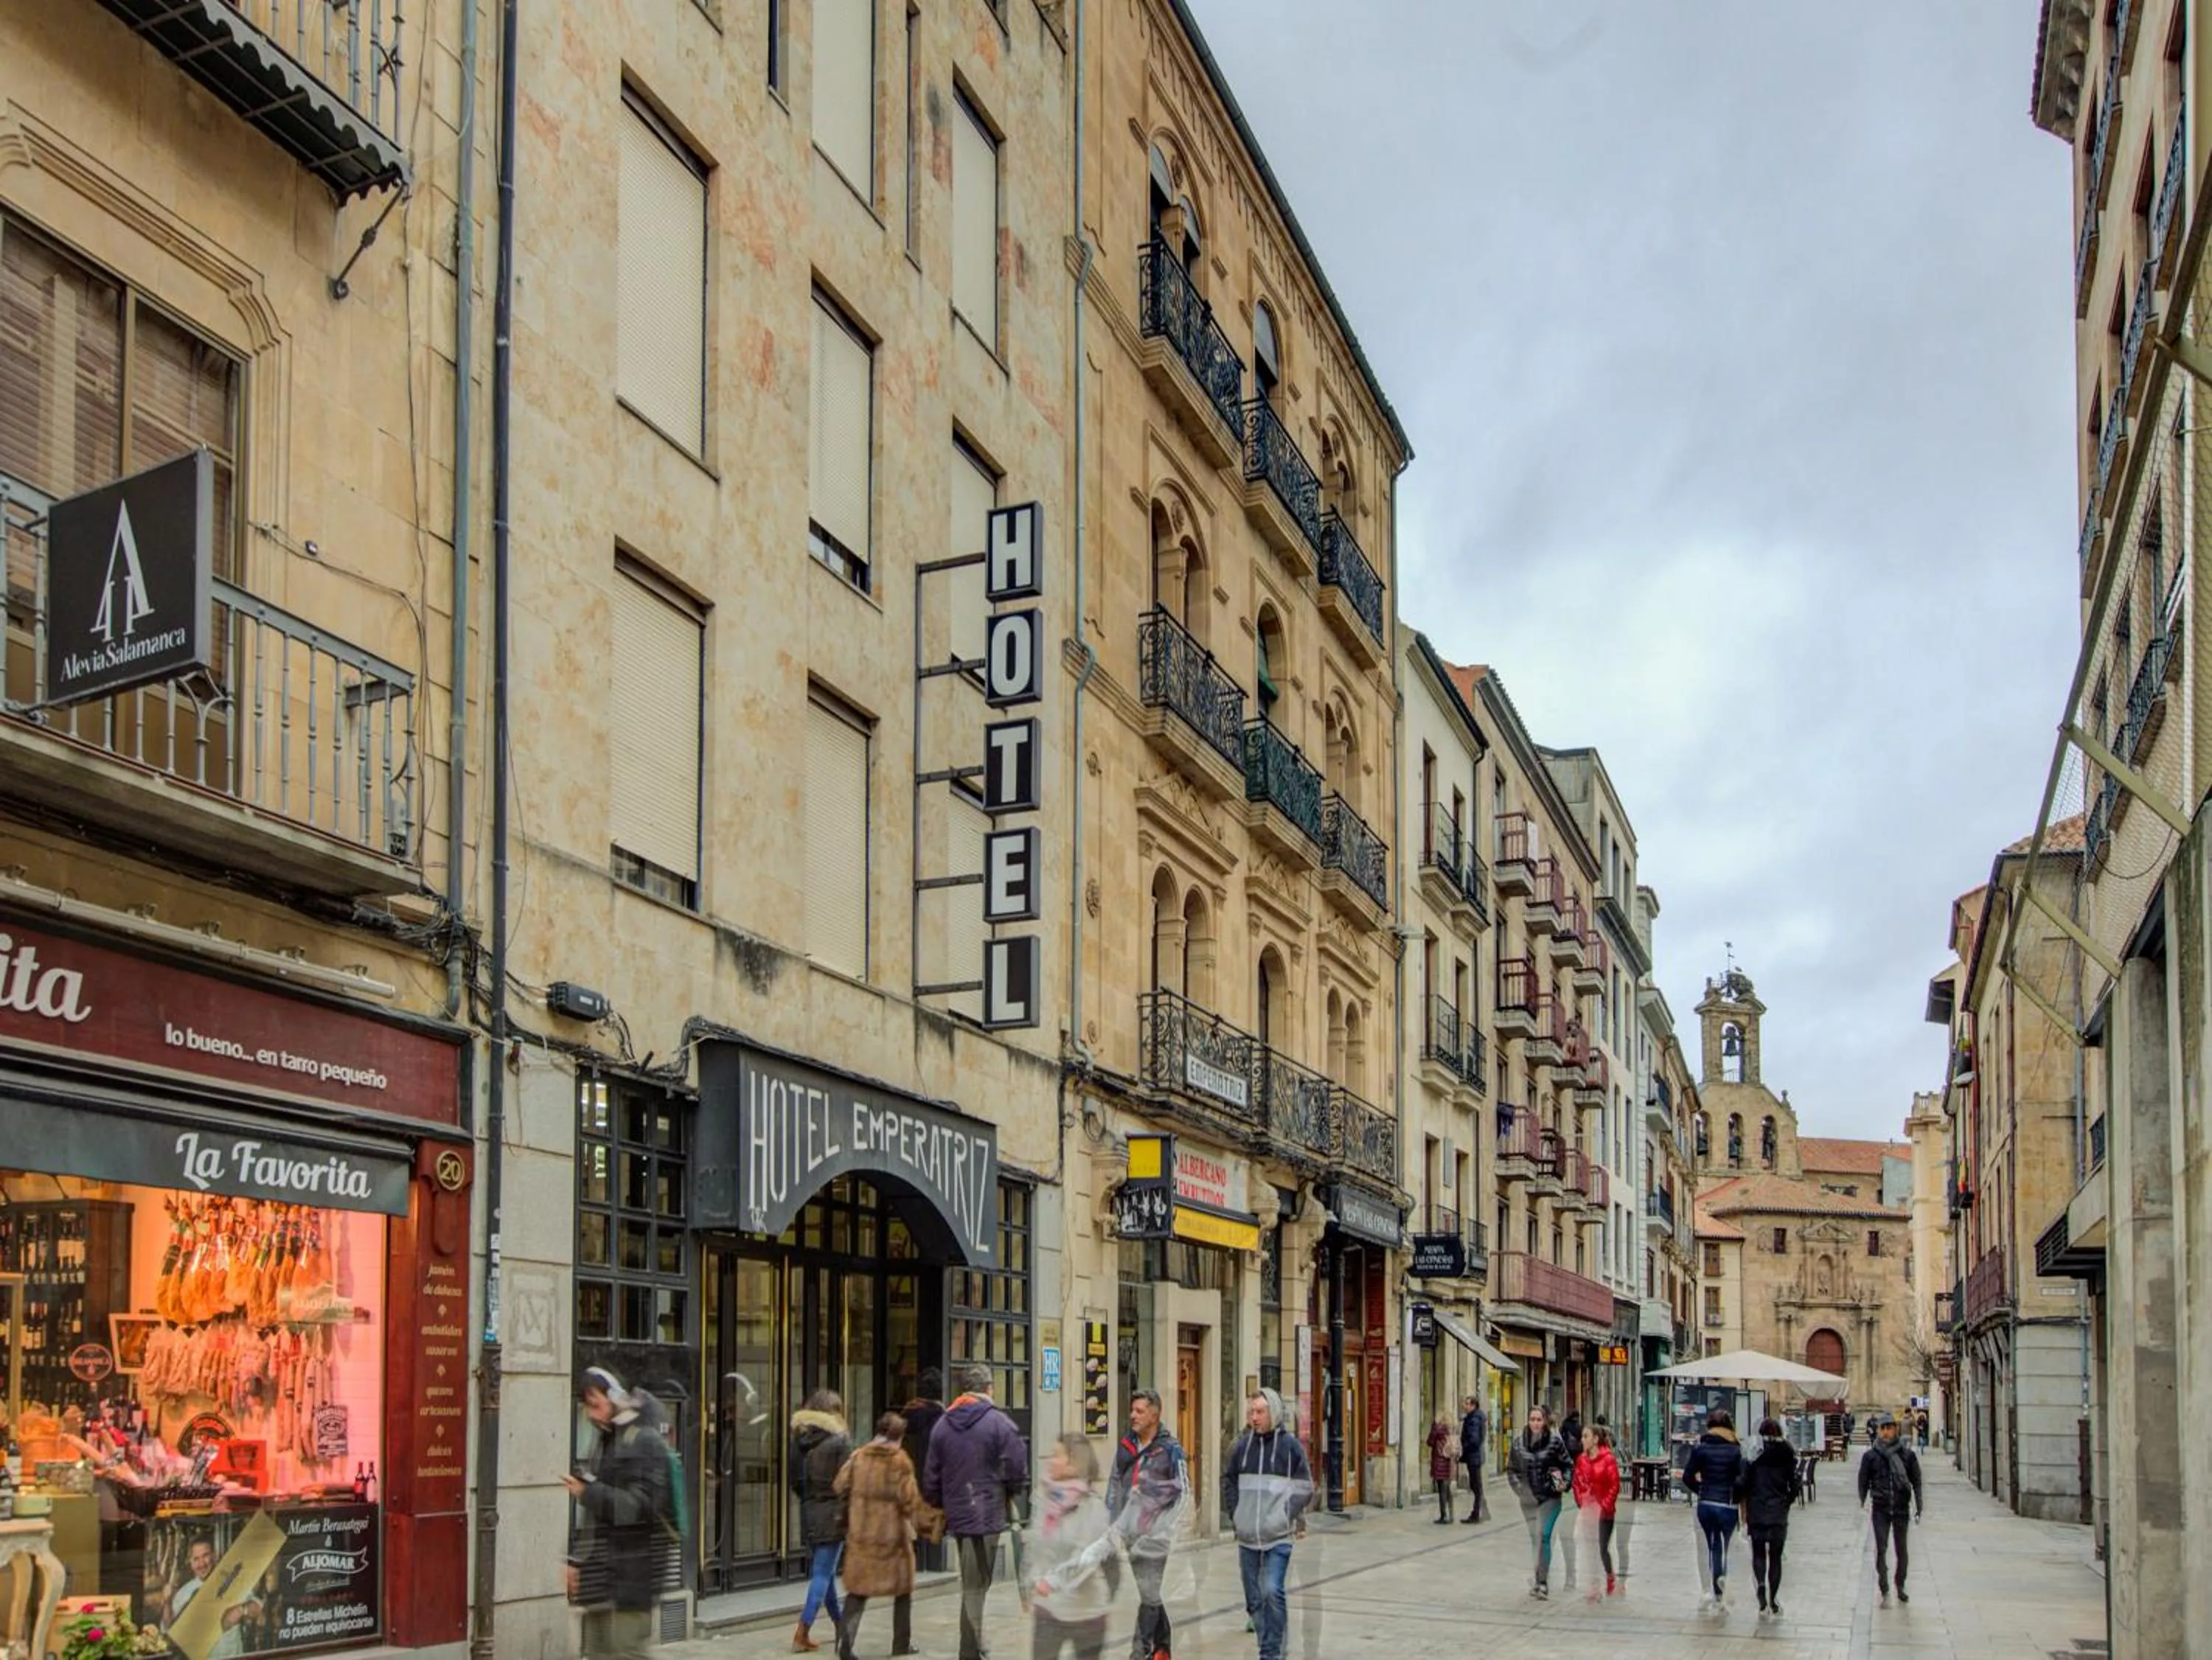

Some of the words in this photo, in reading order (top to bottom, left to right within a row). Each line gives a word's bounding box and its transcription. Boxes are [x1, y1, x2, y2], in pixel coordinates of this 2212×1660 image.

[989, 509, 1031, 1022] HOTEL
[165, 1022, 184, 1046] lo
[186, 1028, 254, 1062] bueno...
[257, 1048, 278, 1066] en
[281, 1050, 318, 1075] tarro
[320, 1063, 387, 1089] pequeño
[1190, 1060, 1243, 1101] EMPERATRIZ
[175, 1132, 225, 1190] La
[232, 1140, 372, 1199] Favorita
[442, 1160, 461, 1182] 20
[749, 1070, 840, 1213] HOTEL
[852, 1101, 990, 1252] EMPERATRIZ
[302, 1554, 355, 1570] ALJOMAR
[279, 1627, 291, 1639] no
[291, 1623, 324, 1640] pueden
[325, 1616, 374, 1634] equivocarse
[287, 1607, 294, 1625] 8
[296, 1608, 333, 1624] Estrellas
